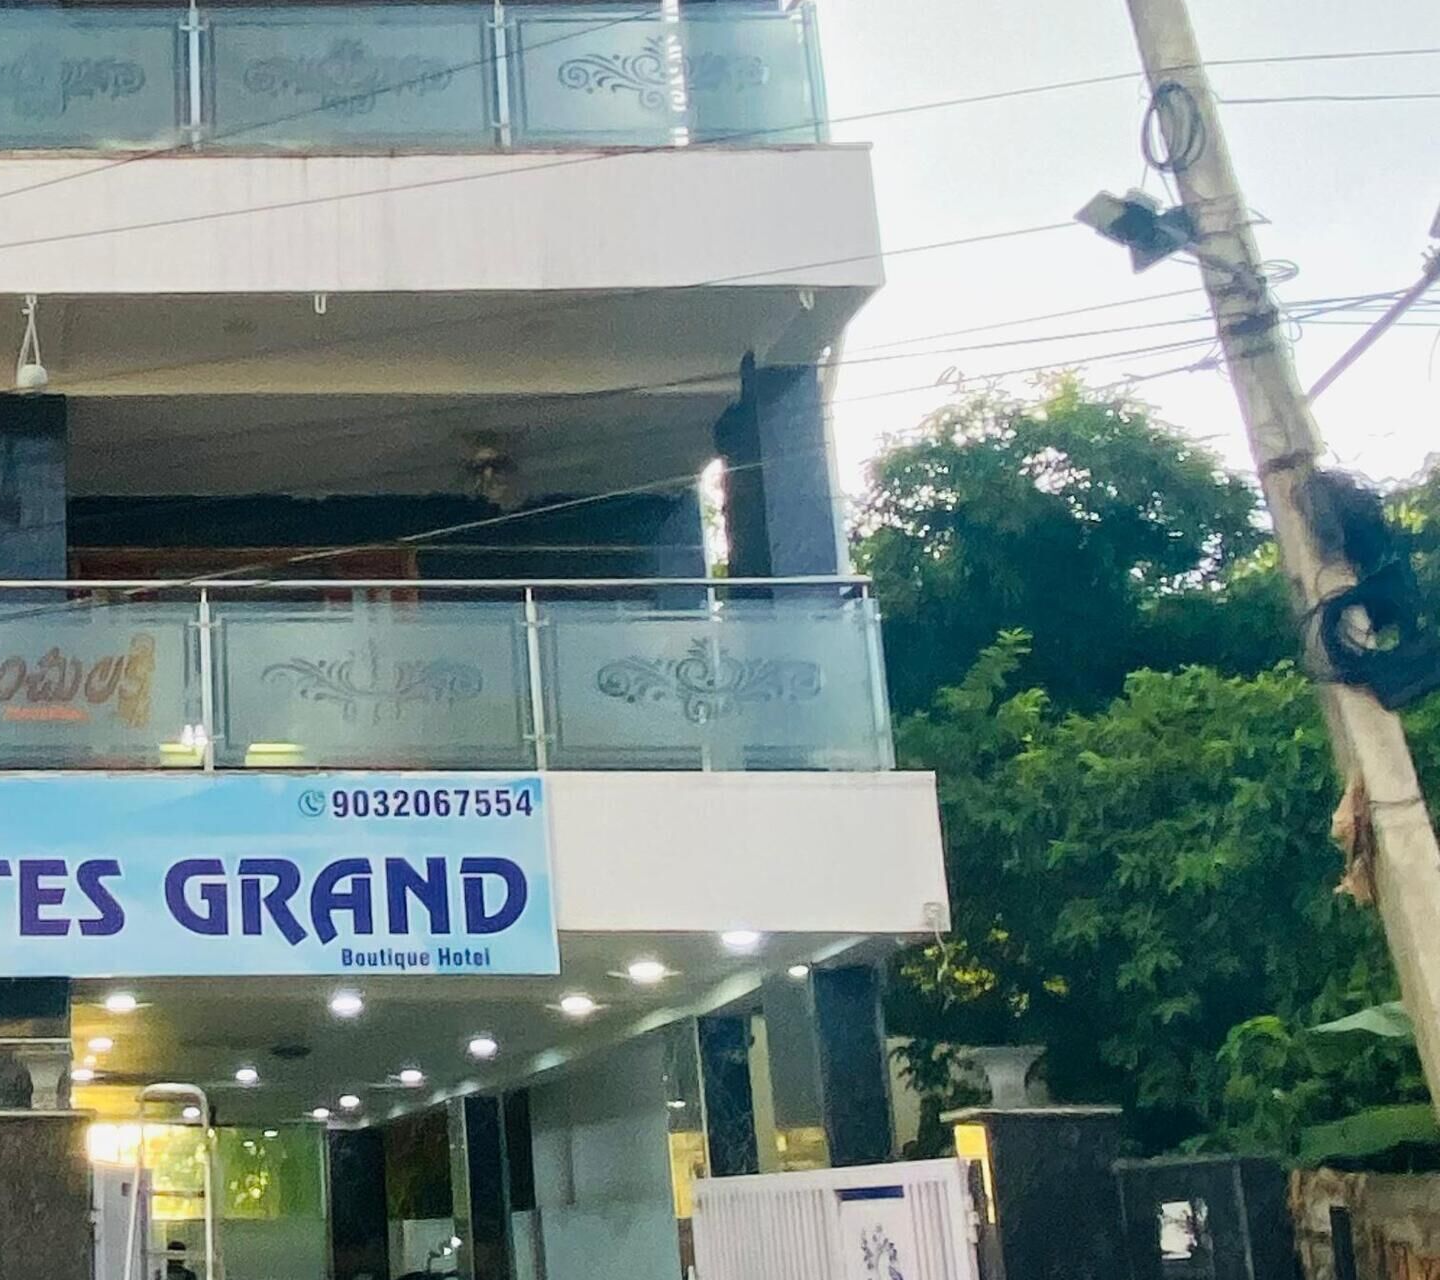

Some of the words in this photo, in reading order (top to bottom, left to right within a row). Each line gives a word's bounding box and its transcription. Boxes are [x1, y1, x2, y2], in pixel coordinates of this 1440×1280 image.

[332, 789, 534, 818] 9032067554
[164, 856, 528, 947] GRAND
[342, 948, 430, 971] Boutique
[439, 946, 491, 967] Hotel
